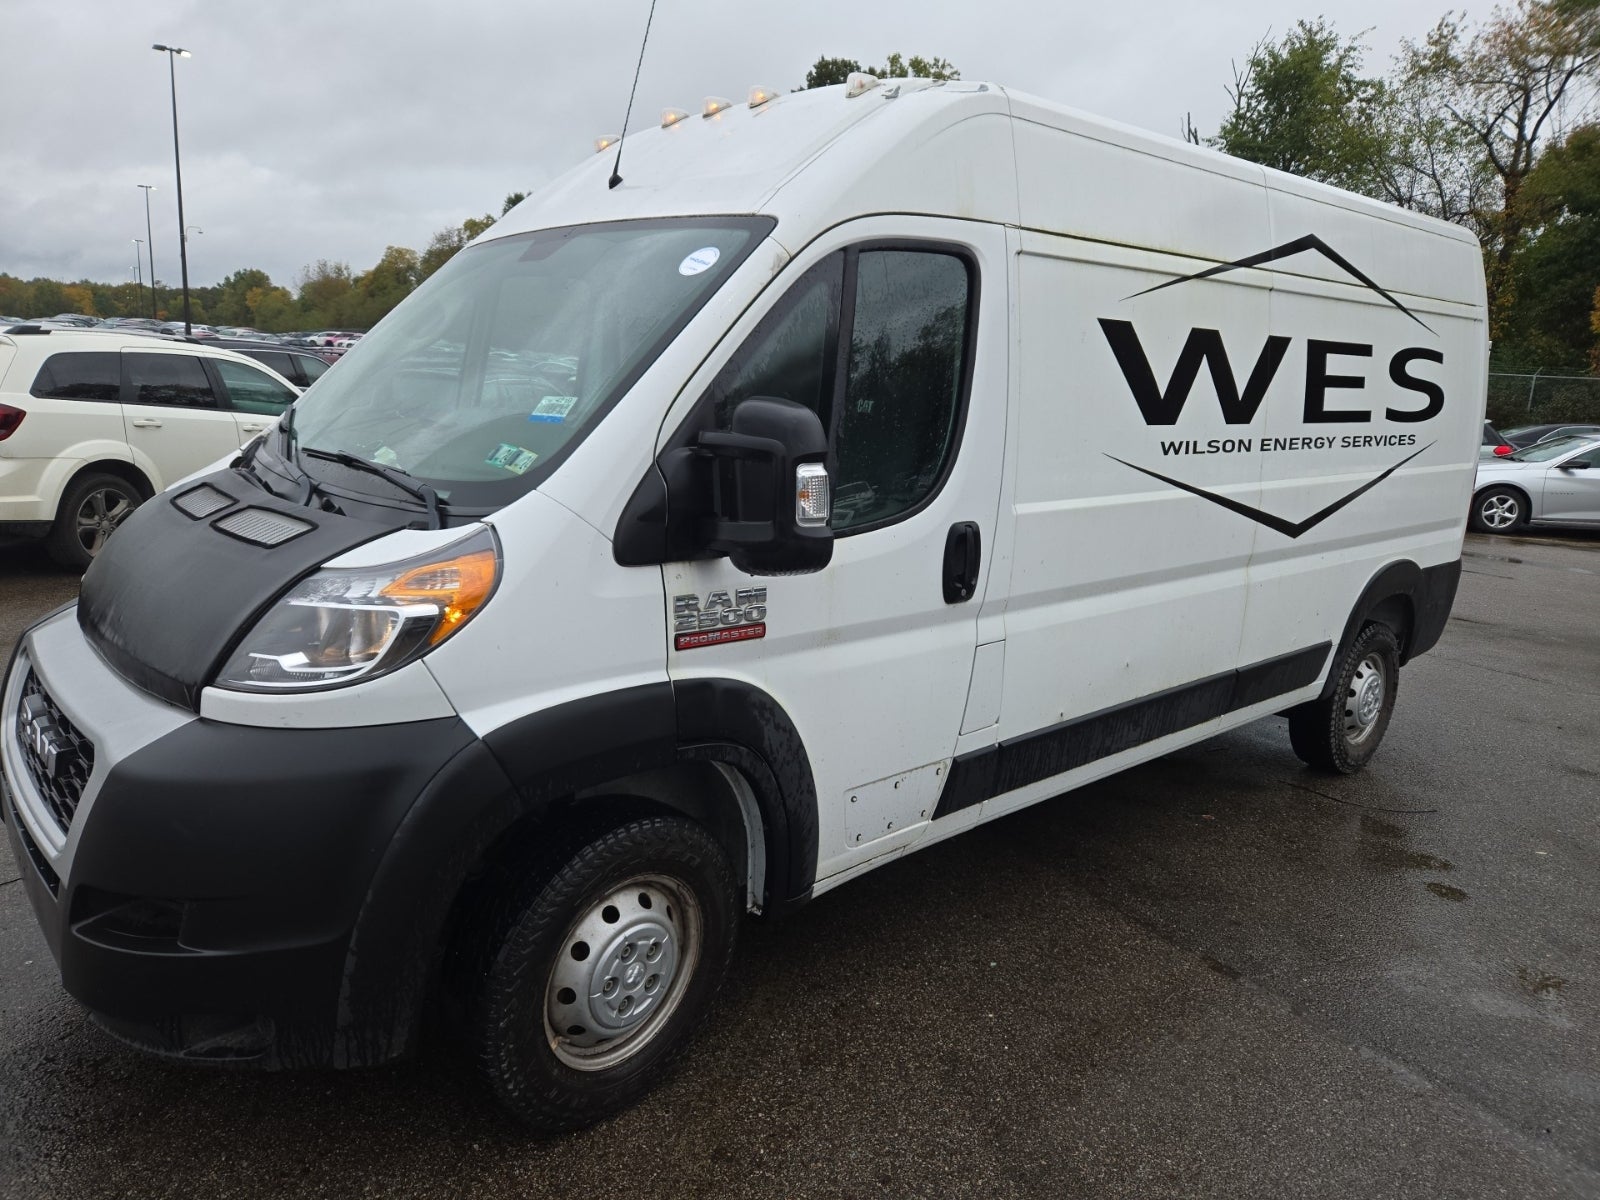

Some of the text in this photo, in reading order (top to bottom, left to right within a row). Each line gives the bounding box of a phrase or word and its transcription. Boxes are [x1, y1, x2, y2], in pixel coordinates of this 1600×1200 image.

[1097, 317, 1445, 426] WES
[1160, 434, 1416, 456] WILSON ENERGY SERVICES
[673, 586, 767, 613] RAM
